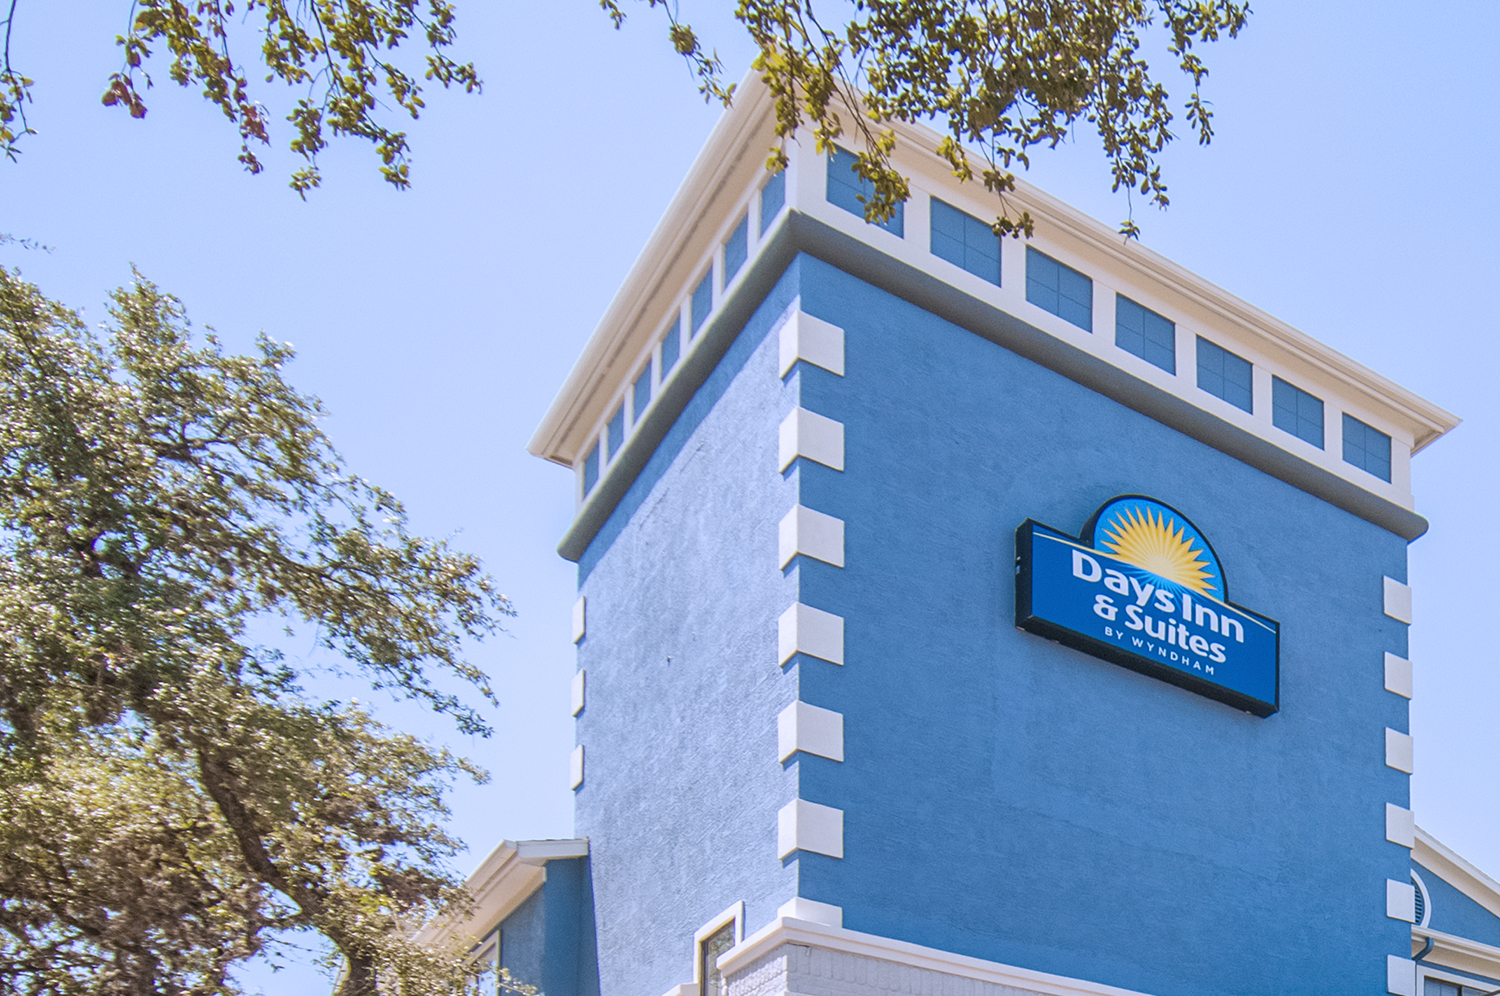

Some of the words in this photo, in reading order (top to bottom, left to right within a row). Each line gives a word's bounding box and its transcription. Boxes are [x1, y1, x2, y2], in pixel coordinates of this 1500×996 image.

[1072, 549, 1175, 613] Days
[1182, 593, 1244, 643] Inn
[1093, 594, 1118, 621] &
[1124, 604, 1226, 663] Suites
[1104, 626, 1124, 640] BY
[1131, 636, 1214, 676] WYNDHAM
